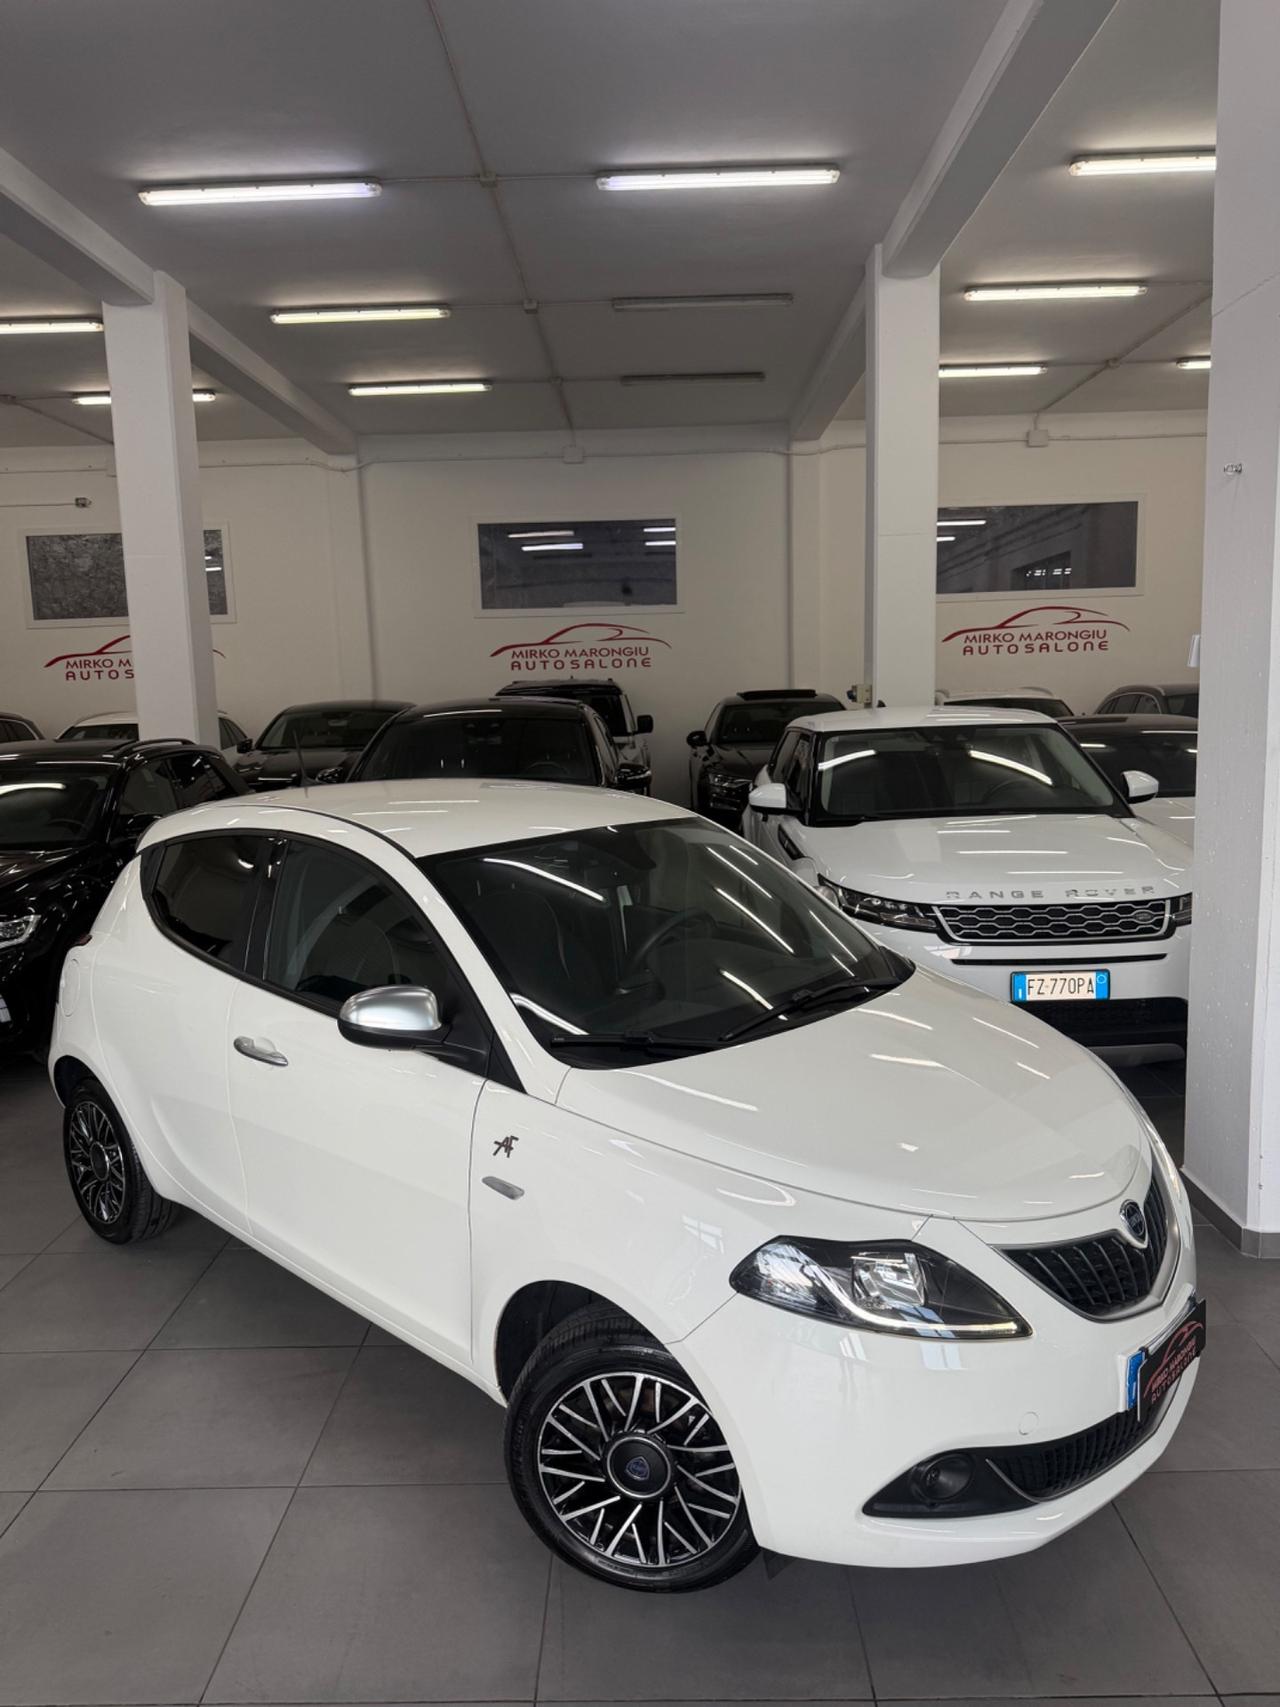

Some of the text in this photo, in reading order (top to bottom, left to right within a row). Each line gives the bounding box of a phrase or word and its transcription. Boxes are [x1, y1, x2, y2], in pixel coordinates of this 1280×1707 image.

[964, 629, 1107, 644] MIRKO MARONGIU
[511, 646, 649, 660] MIRKO MARONGIU
[962, 640, 1109, 656] AUTOSALONE
[65, 658, 114, 669] MIRKO
[510, 657, 652, 671] AUTOSALONE
[946, 885, 1155, 899] RANGE ROVER
